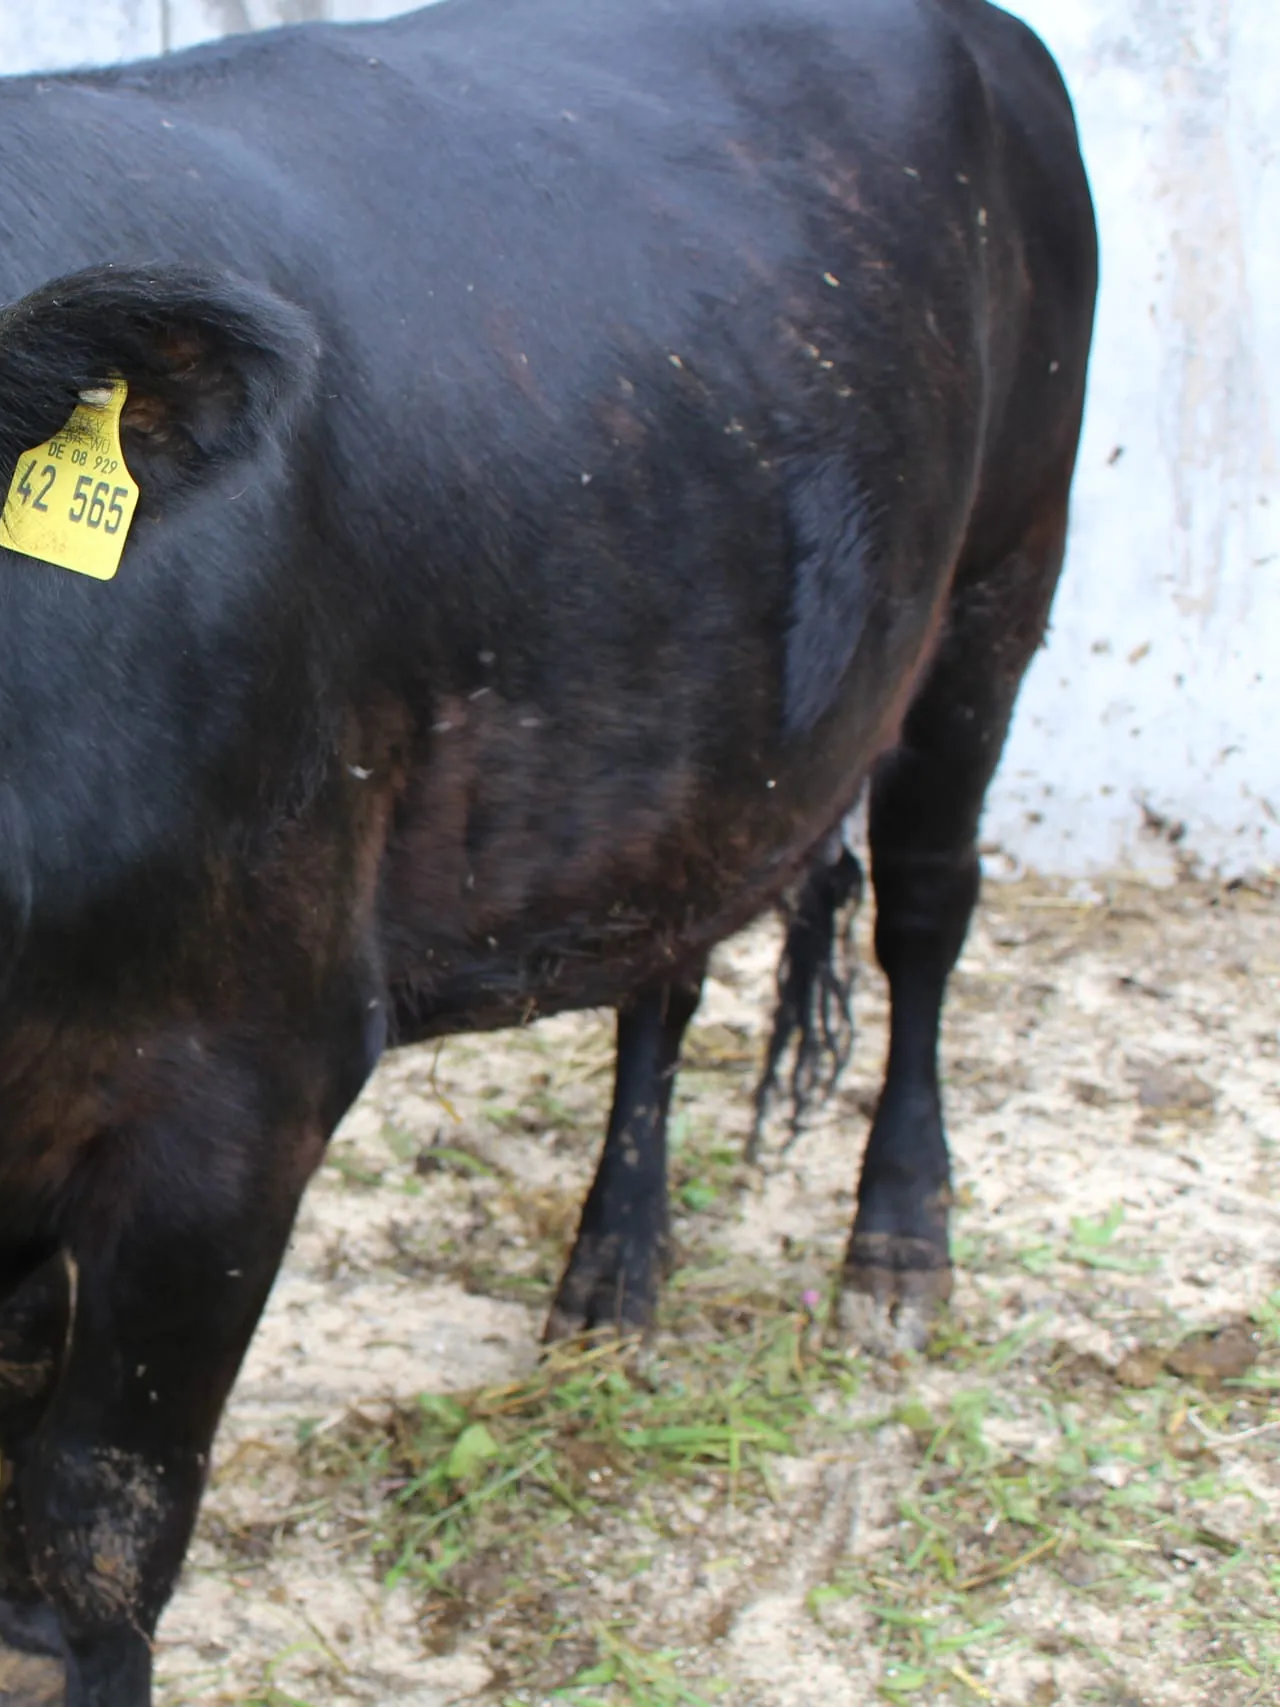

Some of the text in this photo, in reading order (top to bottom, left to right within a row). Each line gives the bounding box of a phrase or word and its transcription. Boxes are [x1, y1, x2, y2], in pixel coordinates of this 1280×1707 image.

[48, 442, 118, 475] DE 08 929
[17, 459, 128, 535] 42 565
